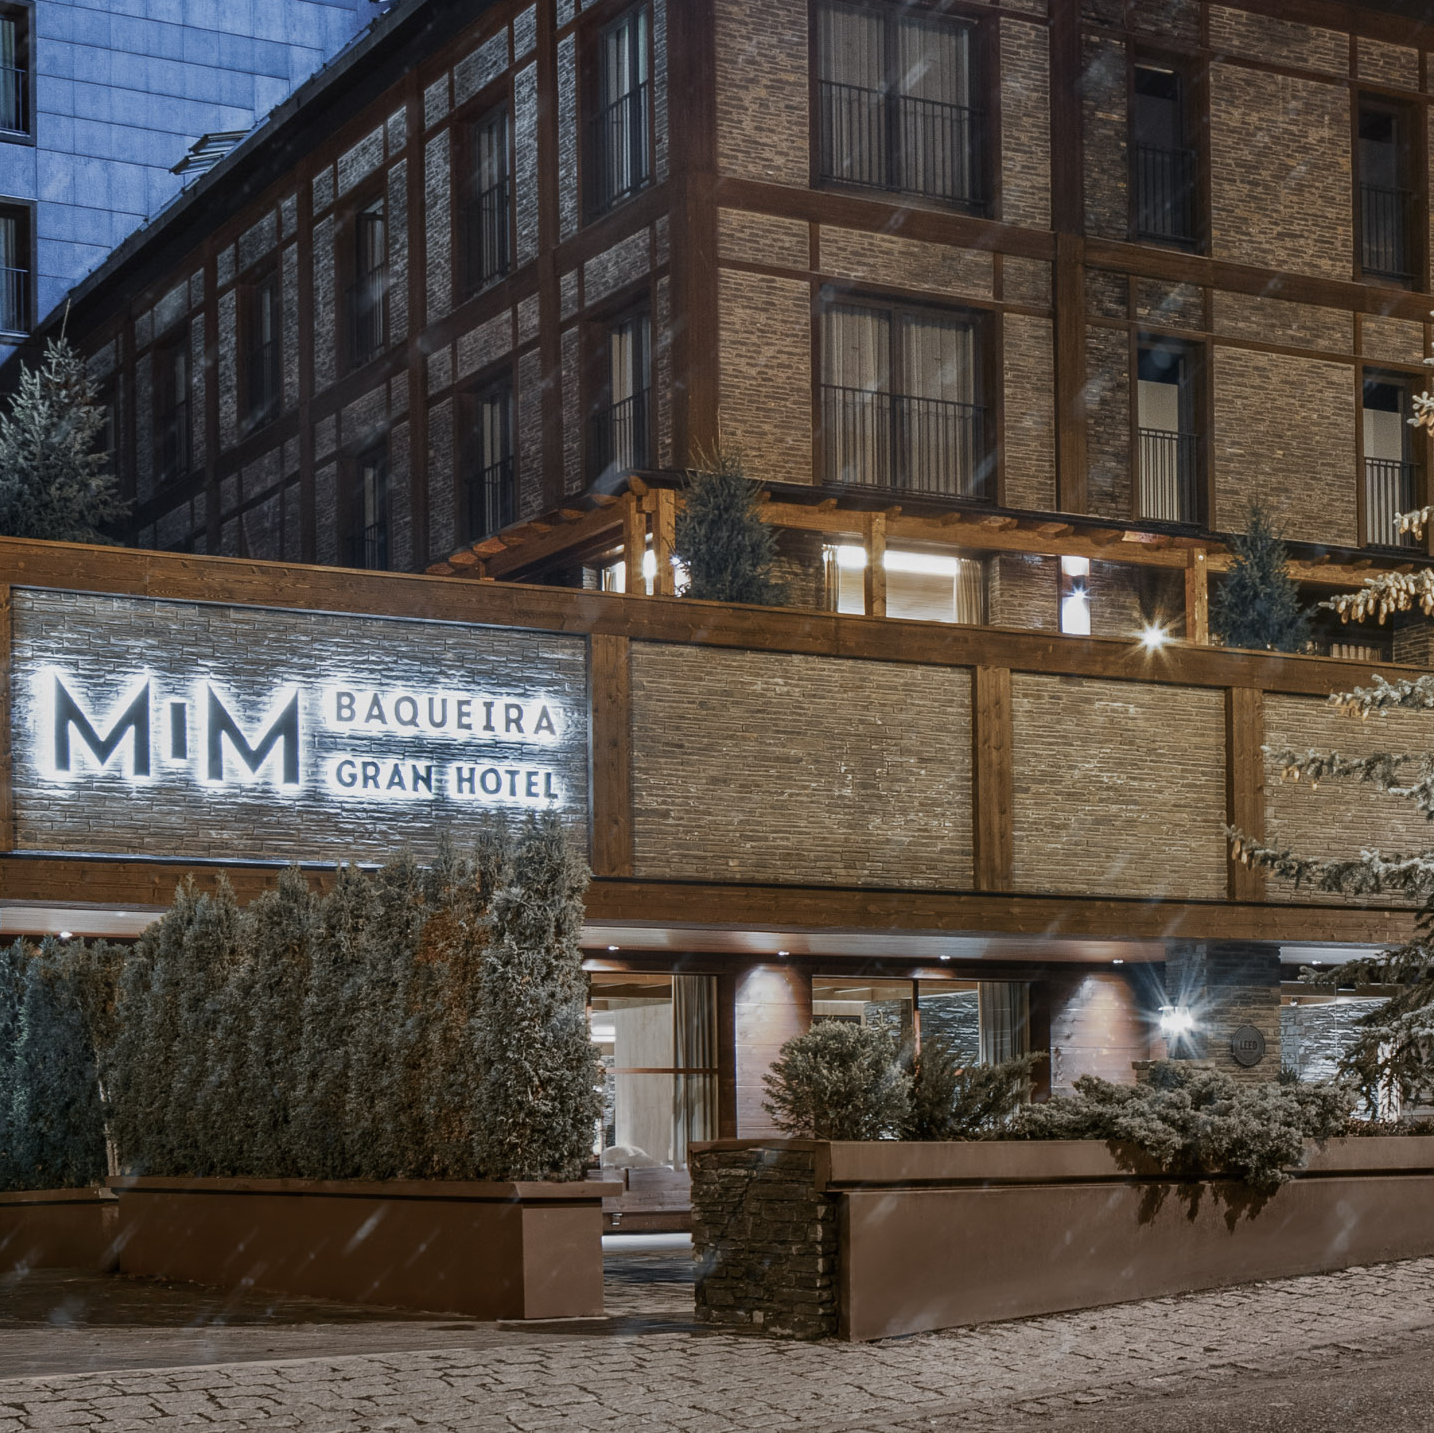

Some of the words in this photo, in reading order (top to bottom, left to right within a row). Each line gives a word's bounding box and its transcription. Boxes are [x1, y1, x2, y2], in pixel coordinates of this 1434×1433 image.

[335, 691, 557, 736] BAQUEIRA
[335, 759, 434, 793] GRAN
[455, 766, 559, 799] HOTEL
[1239, 1040, 1258, 1050] LEED
